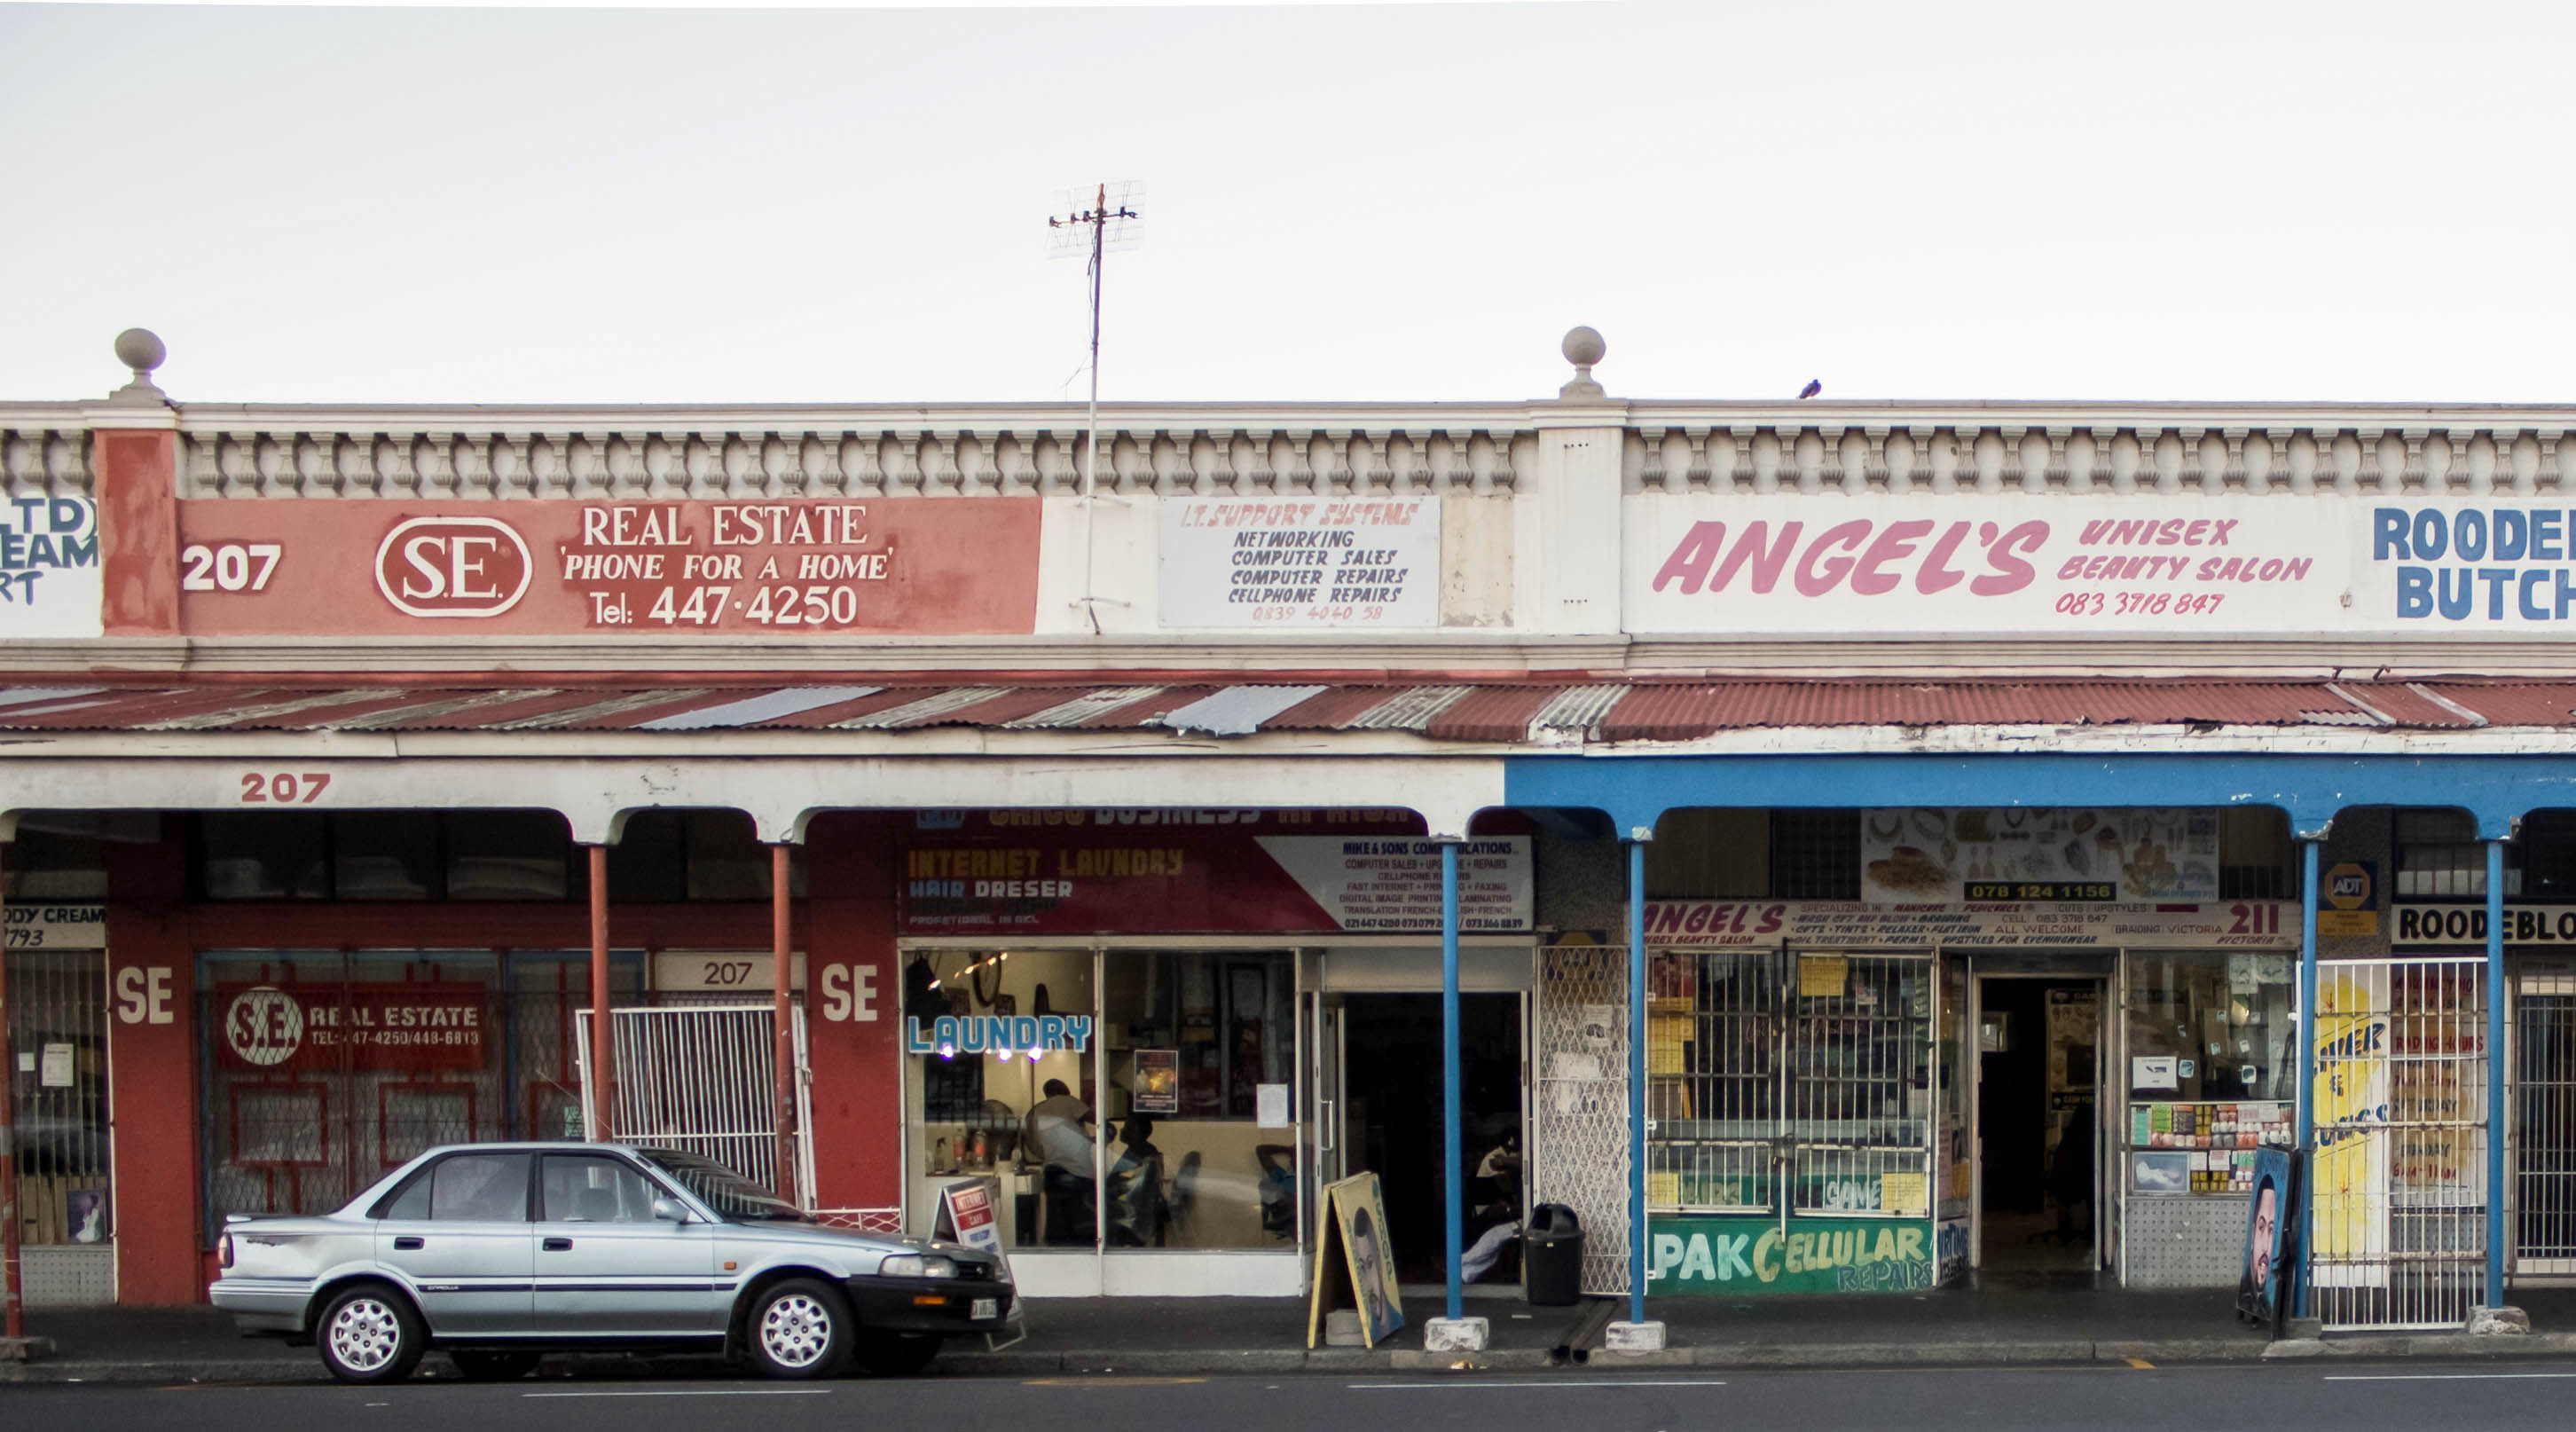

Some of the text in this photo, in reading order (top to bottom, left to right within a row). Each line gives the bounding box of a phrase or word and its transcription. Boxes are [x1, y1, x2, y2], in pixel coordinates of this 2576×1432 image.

[584, 505, 868, 546] REAL ESTATE
[1319, 503, 1420, 526] SYSTEMS
[1233, 531, 1355, 548] NETWORKING
[2078, 519, 2238, 547] UNISEX
[2374, 507, 2576, 562] ROODE
[182, 544, 282, 591] 207
[403, 536, 504, 600] S.E.
[683, 555, 743, 579] FOR
[758, 555, 780, 579] A
[1231, 549, 1398, 566] COMPUTER SALES
[1652, 518, 2050, 597] ANGEL'S
[2057, 555, 2313, 583] BEAUTY SALON
[1230, 568, 1409, 585] COMPUTER REPAIRS
[1229, 587, 1402, 604] CELLPHONE REPAIRS
[2055, 592, 2225, 616] 083 3718 847
[590, 592, 632, 625] Tel:
[241, 773, 332, 804] 207
[1342, 842, 1370, 855] MIKE
[1381, 842, 1409, 855] SONS
[908, 848, 1184, 877] INTERNET LAUNDRY
[1345, 859, 1389, 869] COMPUTER
[1391, 859, 1418, 869] SALES
[909, 879, 1073, 899] HAIR DRESER
[1370, 882, 1415, 891] INTERNET
[2017, 885, 2054, 898] 124
[2334, 877, 2363, 894] ADT
[44, 909, 106, 924] CREAM
[2002, 914, 2027, 924] CELL
[2227, 902, 2279, 934] 211
[1994, 925, 2085, 934] ALL WELCOME
[2168, 925, 2224, 934] VICTORIA
[704, 962, 753, 985] 207
[116, 965, 174, 1025] SE
[821, 963, 878, 1022] SE
[385, 1006, 479, 1027] ESTATE
[907, 1015, 1093, 1054] LAUNDRY
[1653, 1232, 1753, 1280] PAK
[1752, 1226, 1926, 1283] CELLULAR
